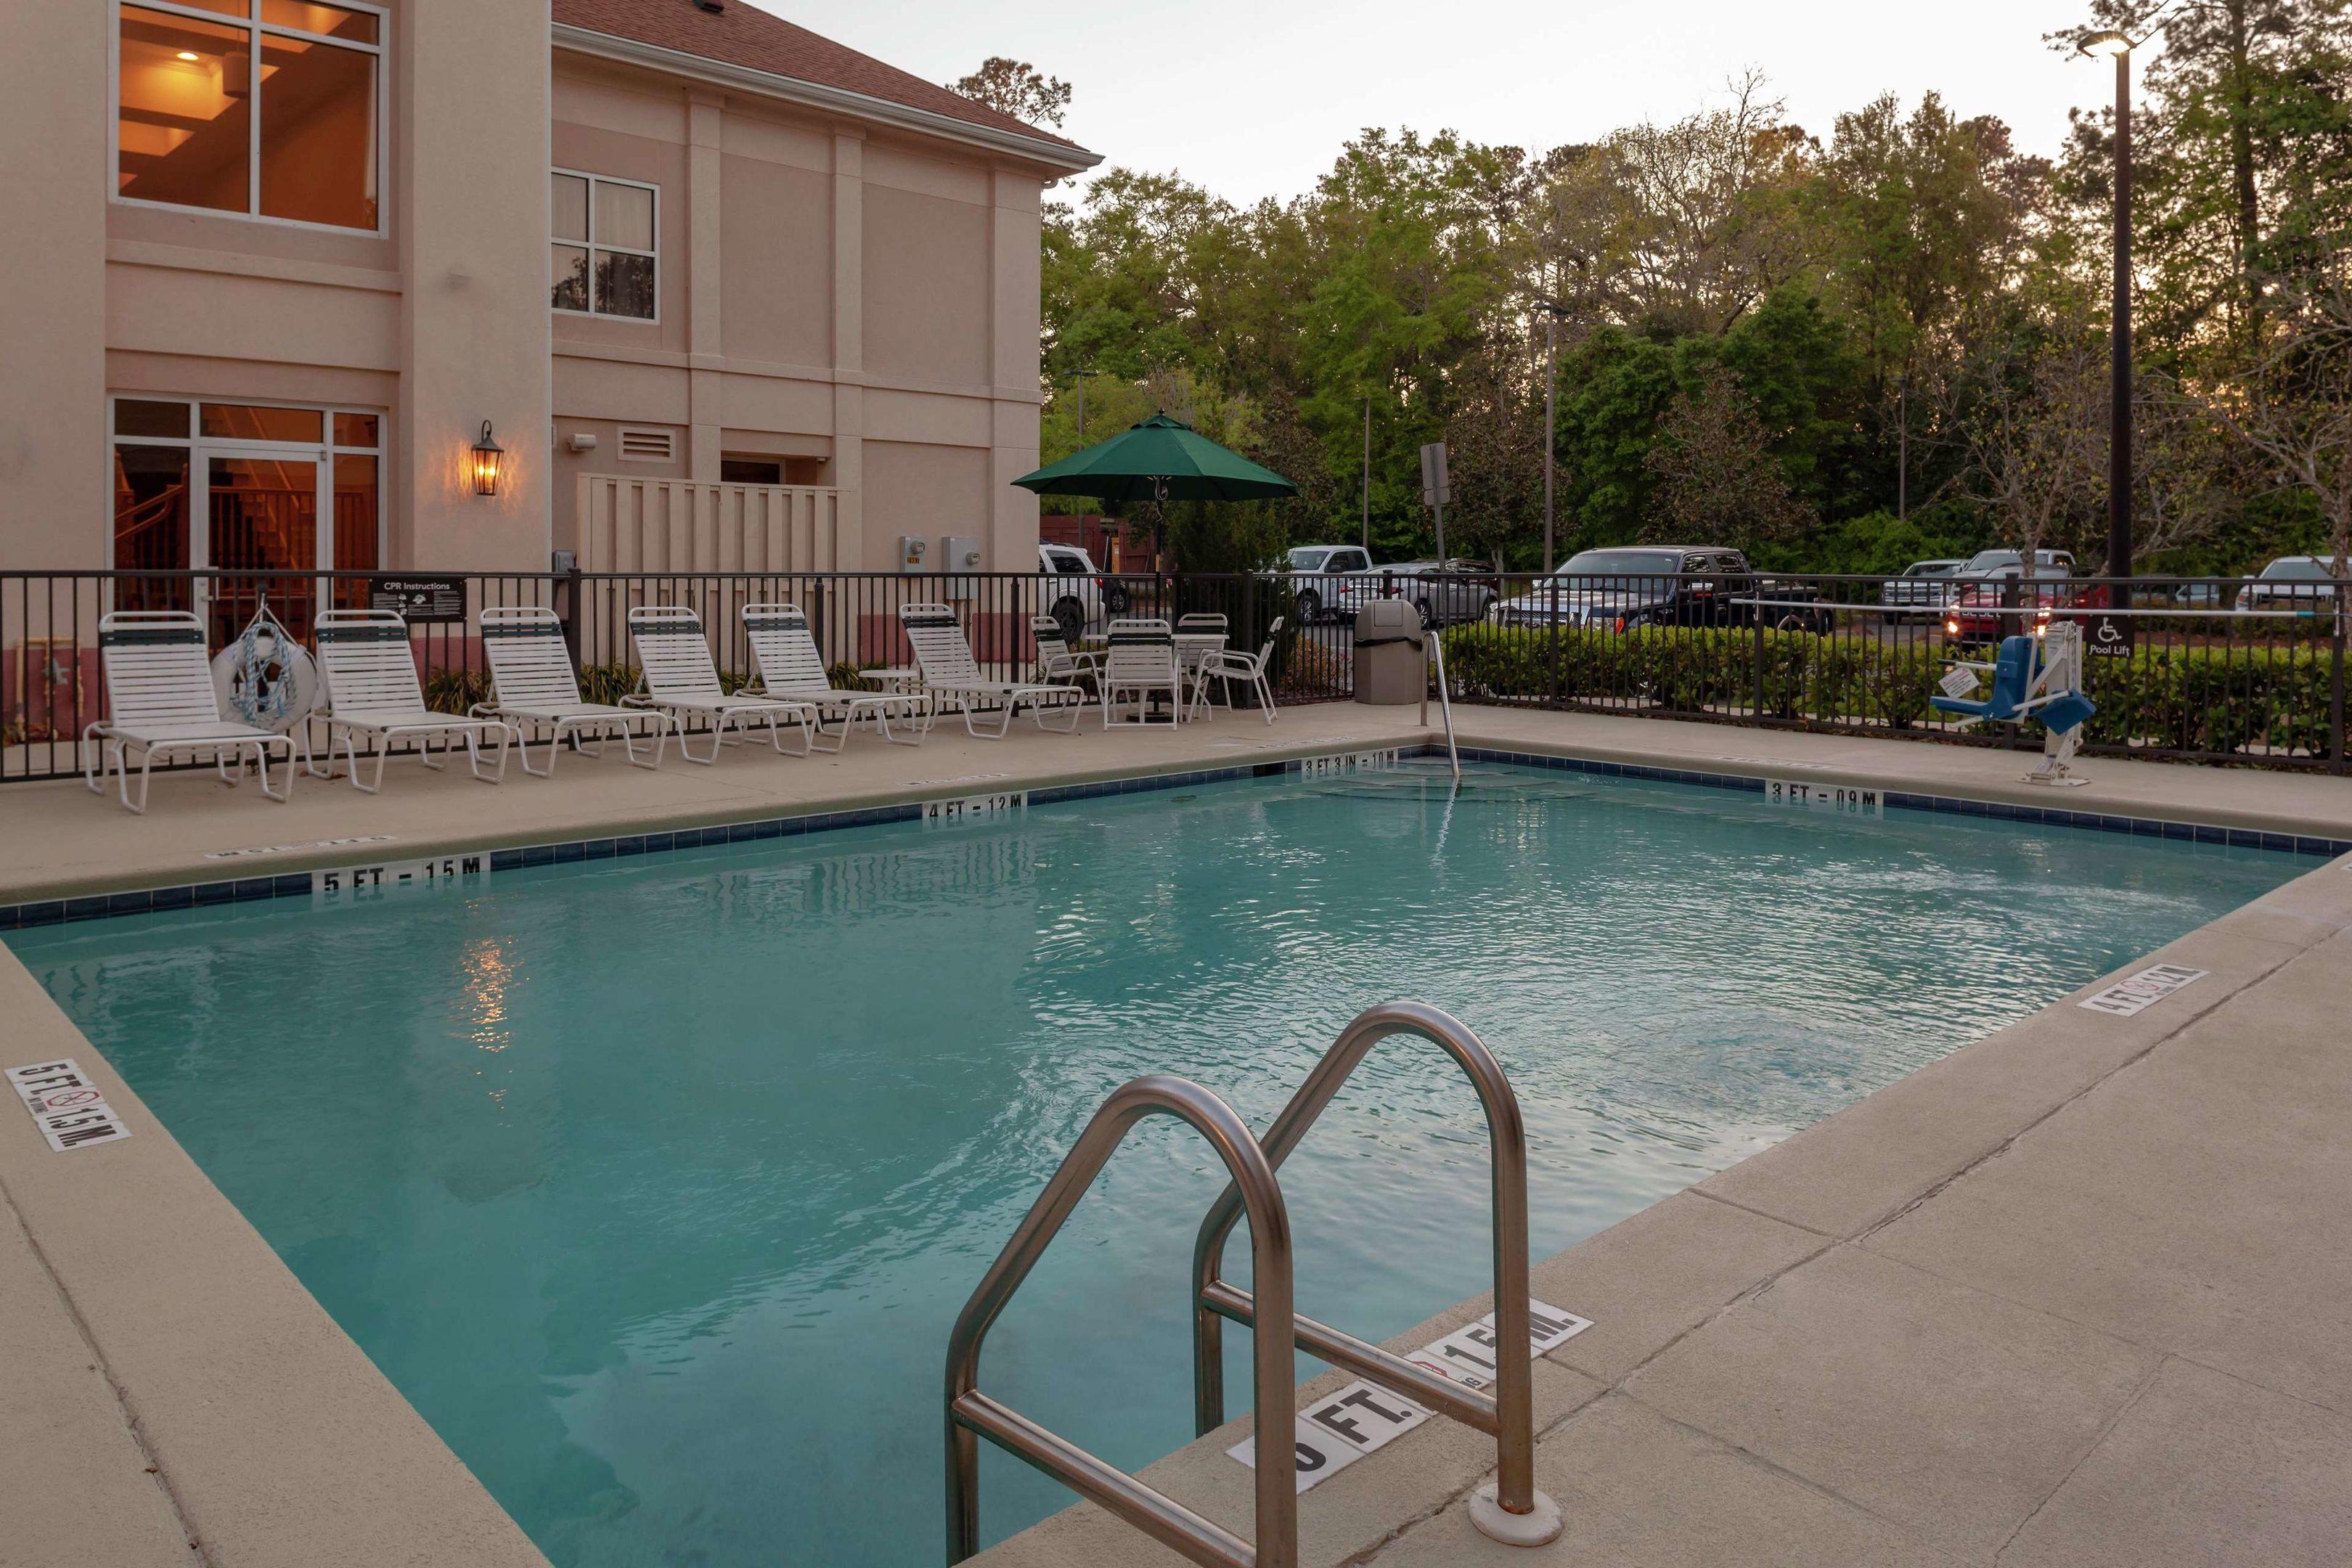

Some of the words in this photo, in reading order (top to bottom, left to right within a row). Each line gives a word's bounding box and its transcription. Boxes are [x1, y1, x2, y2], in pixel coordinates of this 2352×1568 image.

[2090, 645, 2111, 654] Pool
[2114, 645, 2129, 655] Lift
[1306, 760, 1312, 771] 3
[1318, 758, 1329, 770] FT
[1335, 757, 1340, 767] 3
[1345, 755, 1356, 767] IN
[1773, 783, 1781, 796] 3
[1789, 784, 1810, 798] FT
[929, 803, 939, 817] 4
[947, 801, 965, 815] FT
[324, 873, 339, 891] 5
[354, 867, 384, 888] FT
[2092, 1000, 2131, 1010] 4
[18, 1063, 68, 1076] 5
[1311, 1389, 1412, 1445] FT.
